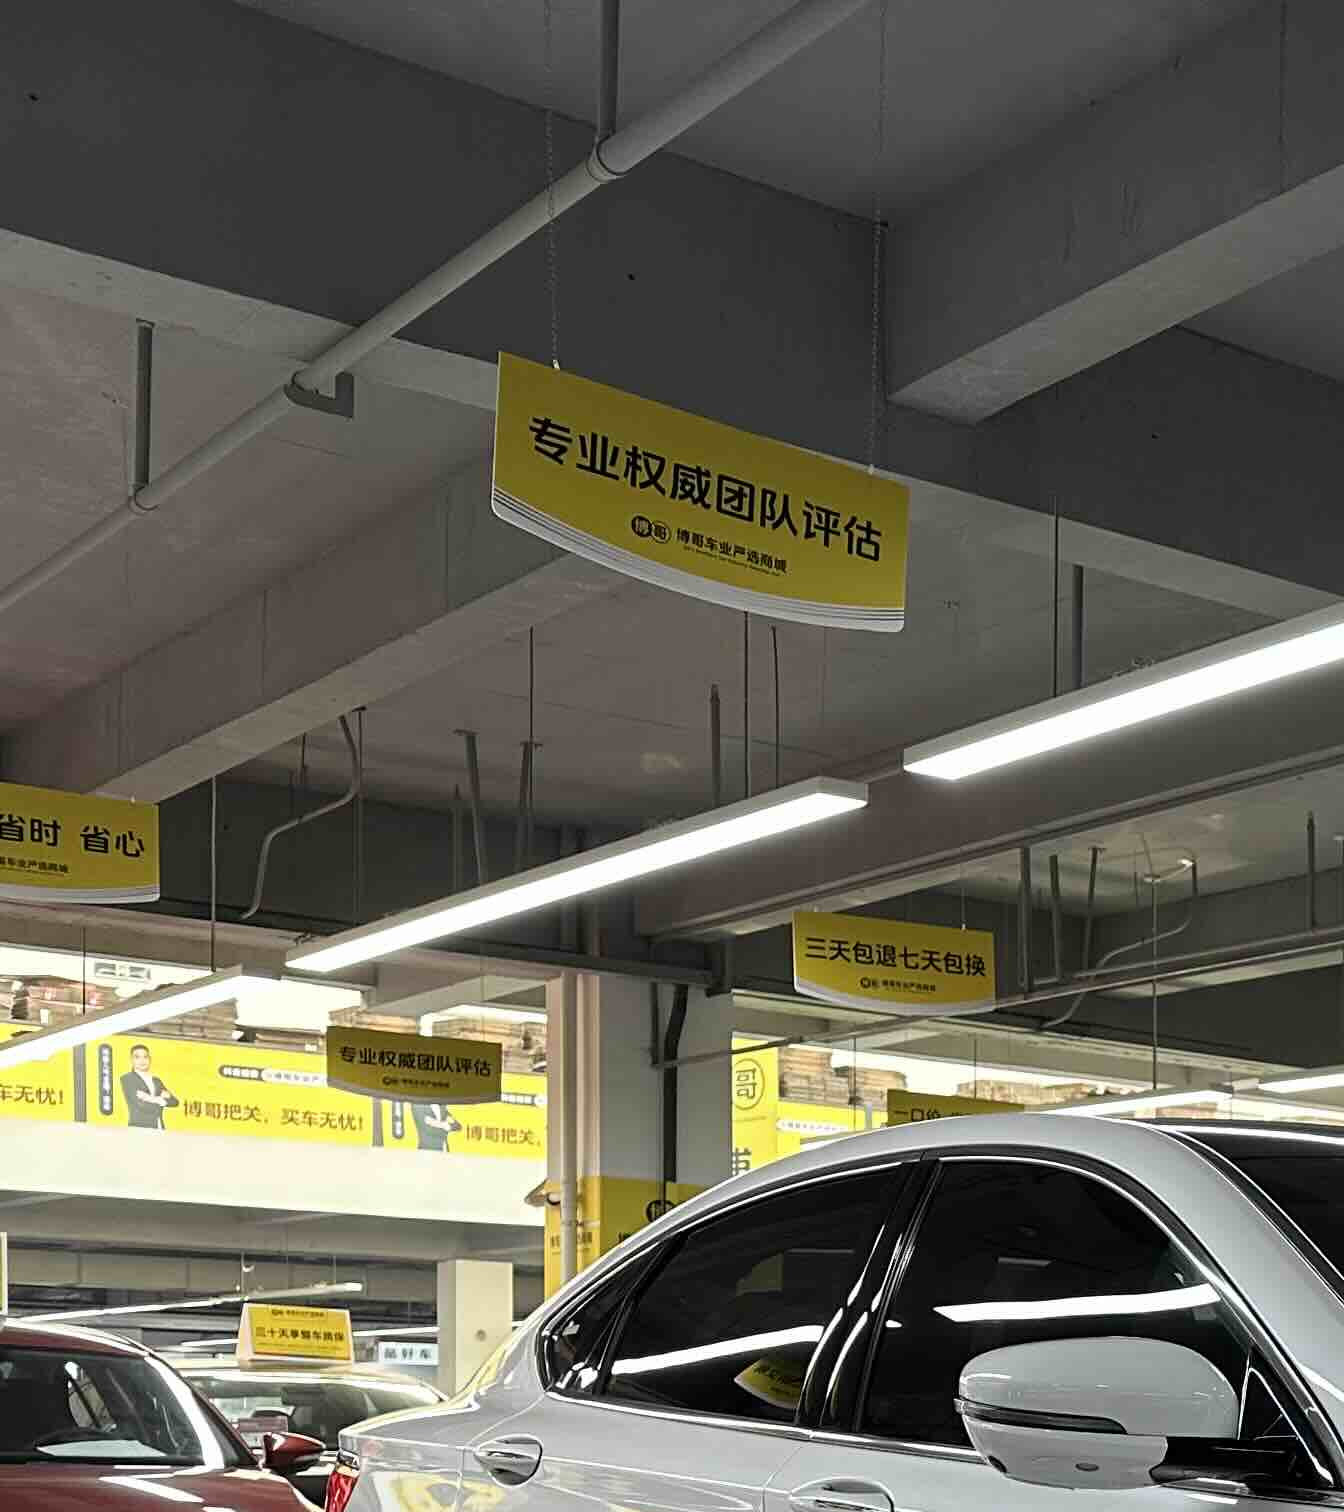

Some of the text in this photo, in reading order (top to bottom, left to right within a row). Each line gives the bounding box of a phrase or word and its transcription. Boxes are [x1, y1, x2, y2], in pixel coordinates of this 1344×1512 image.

[528, 416, 882, 562] 专业权威团队评估
[0, 813, 145, 857] 省时 省心
[805, 937, 986, 976] 三天包退七天包换
[339, 1046, 492, 1078] 专业权威团队评估
